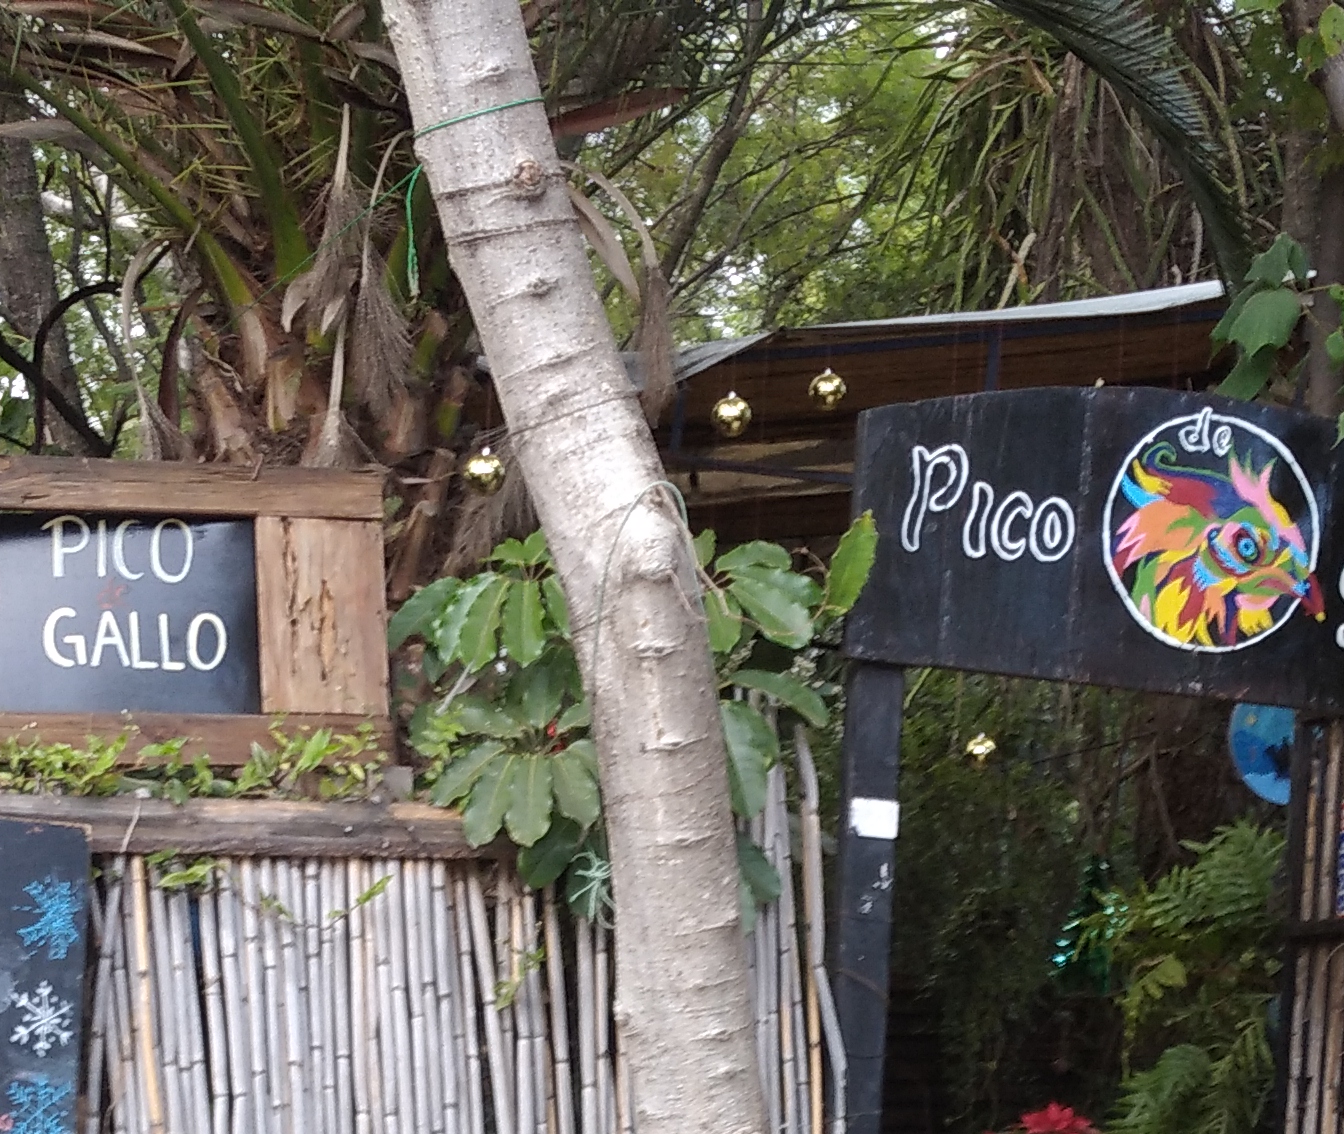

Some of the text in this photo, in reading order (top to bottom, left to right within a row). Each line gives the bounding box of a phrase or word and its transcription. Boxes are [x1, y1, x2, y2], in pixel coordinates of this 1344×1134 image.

[1177, 406, 1233, 457] de
[41, 514, 195, 584] PICO
[42, 606, 228, 671] GALLO
